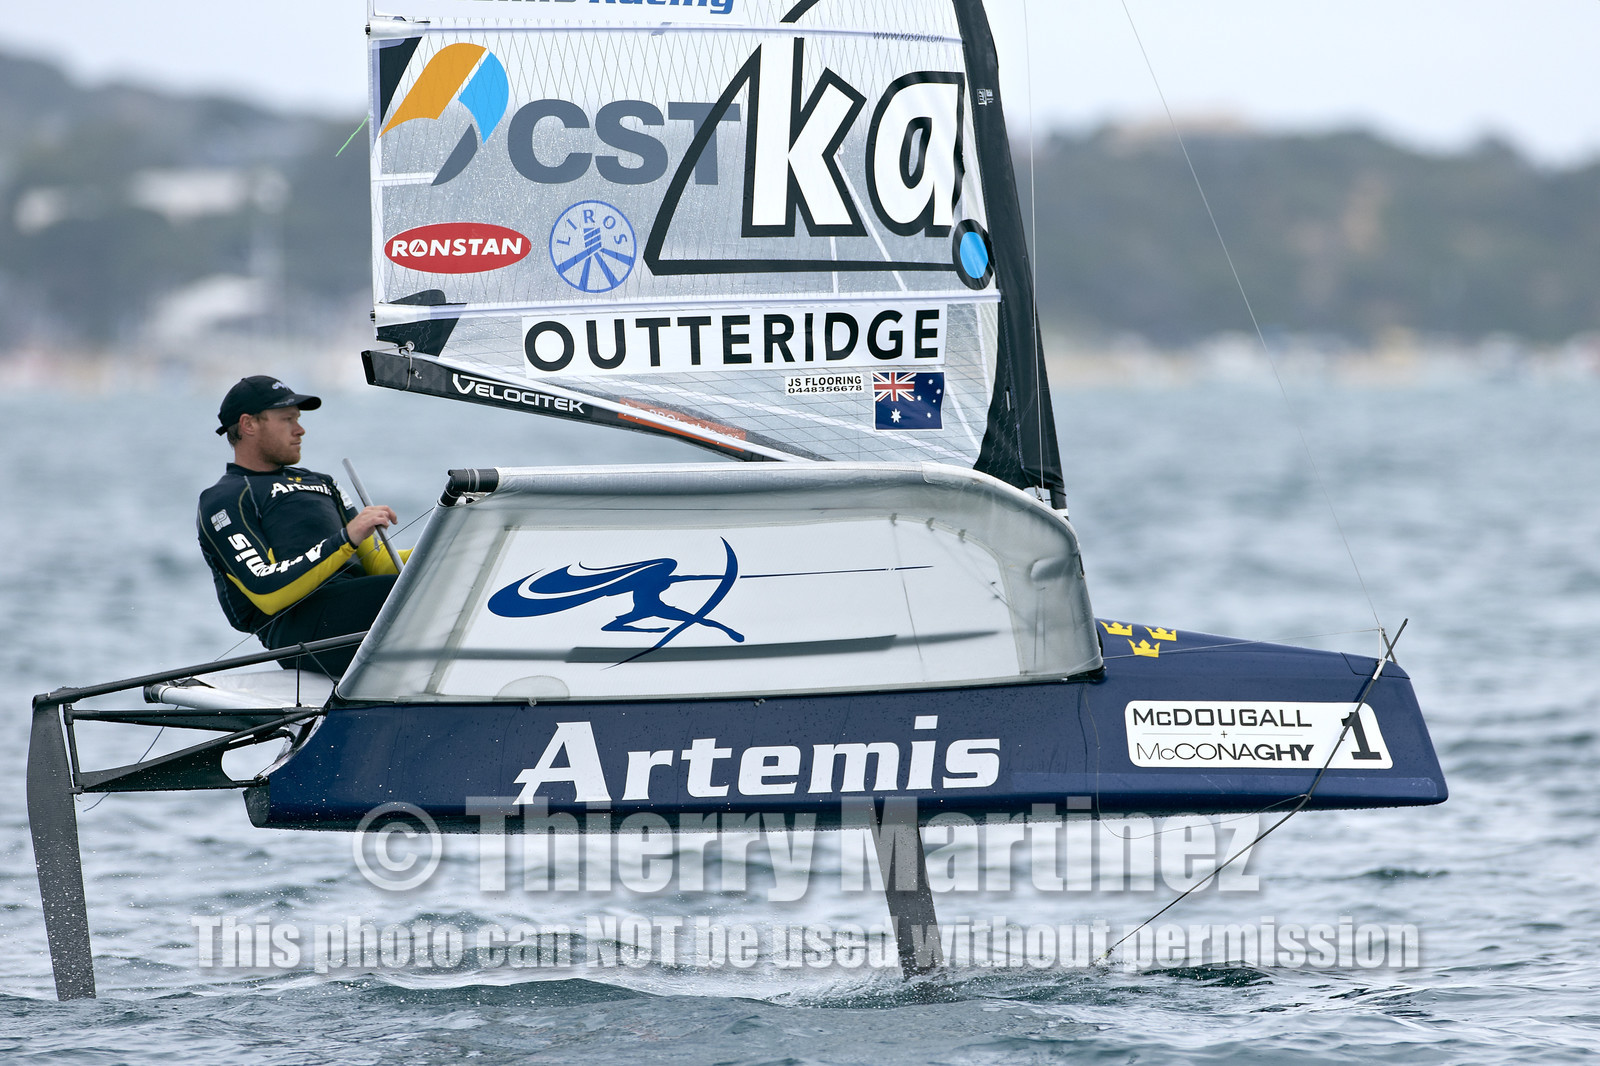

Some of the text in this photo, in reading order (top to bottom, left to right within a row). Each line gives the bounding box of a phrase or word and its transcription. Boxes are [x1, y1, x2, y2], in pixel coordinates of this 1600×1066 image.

[507, 98, 741, 186] CST
[391, 237, 523, 258] RONSTAN
[556, 208, 628, 247] LIROS
[524, 308, 940, 372] OUTTERIDGE
[452, 373, 585, 414] VELOCITEK
[788, 376, 862, 387] JS FLOORING
[1133, 708, 1313, 727] McDOUGALL
[1341, 711, 1382, 760] 1
[512, 715, 1000, 805] Artemis
[1136, 743, 1315, 761] McCONAGHY
